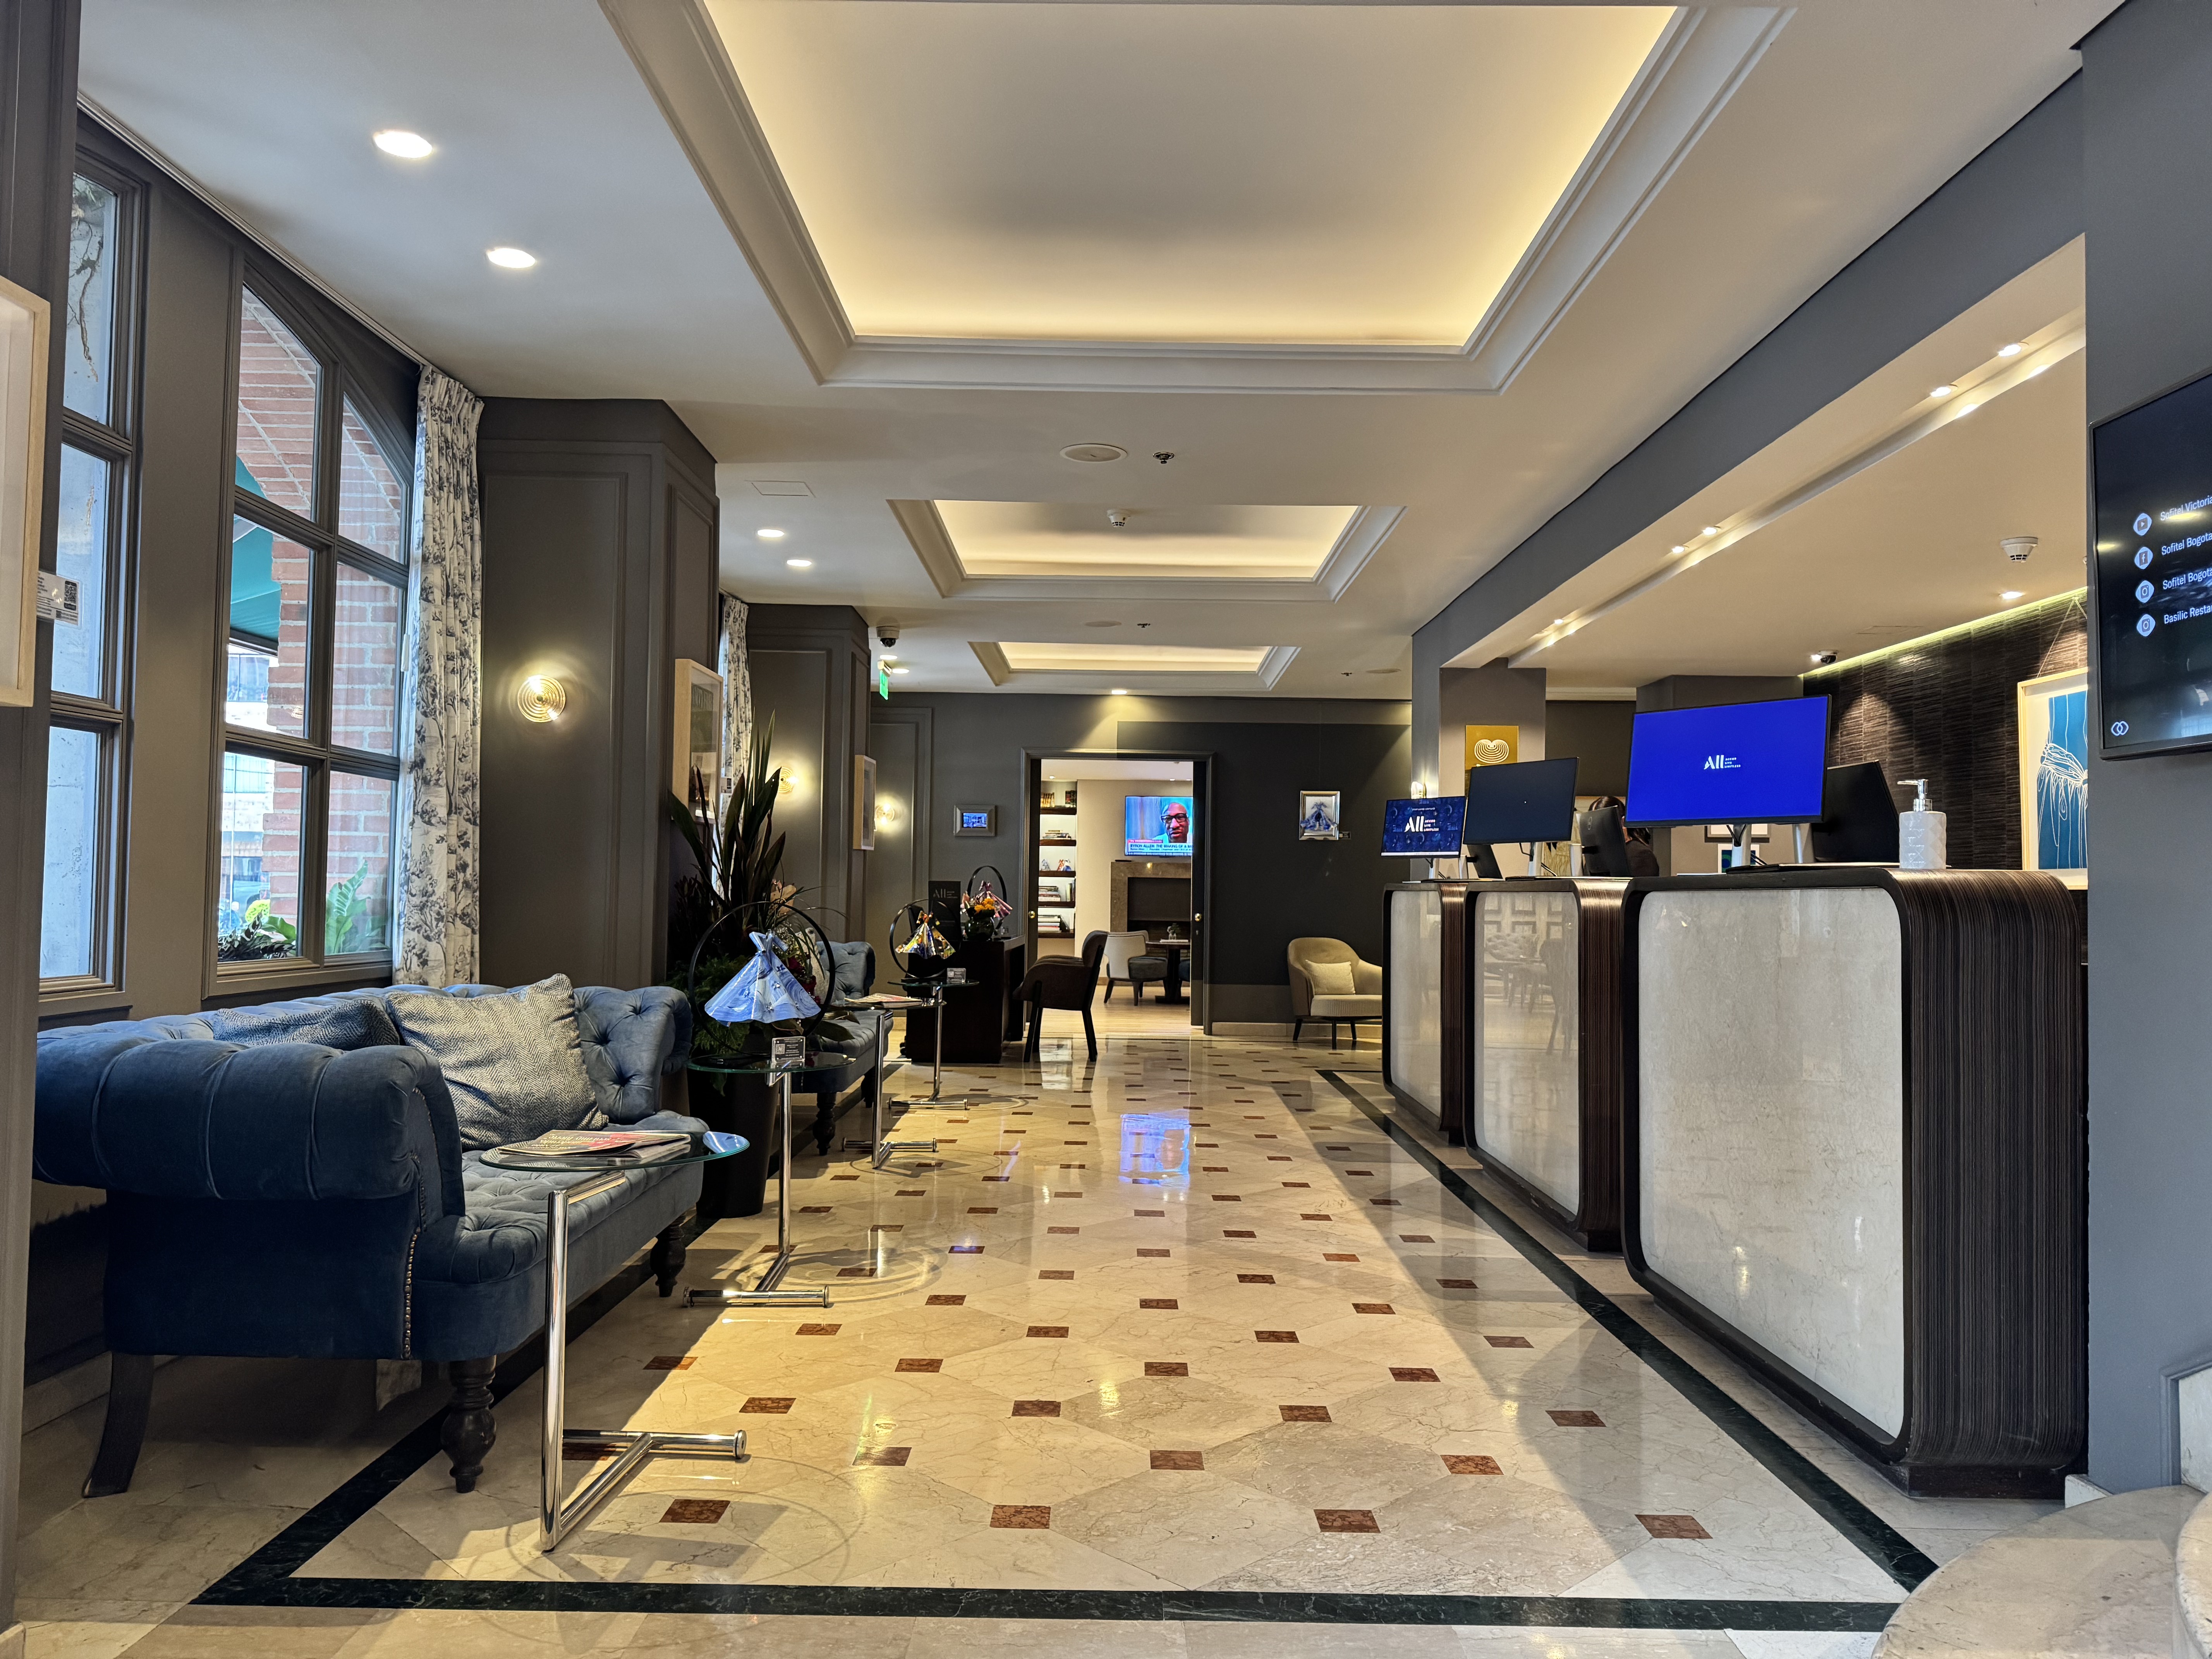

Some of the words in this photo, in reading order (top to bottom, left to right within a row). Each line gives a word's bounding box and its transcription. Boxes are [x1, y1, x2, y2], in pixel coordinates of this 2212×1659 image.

[2160, 505, 2183, 520] Sofitel
[2162, 539, 2185, 555] Sofitel
[2187, 532, 2212, 548] Bogota
[2163, 574, 2186, 590] Sofitel
[2164, 611, 2188, 624] Basilic
[2190, 605, 2212, 618] Resta
